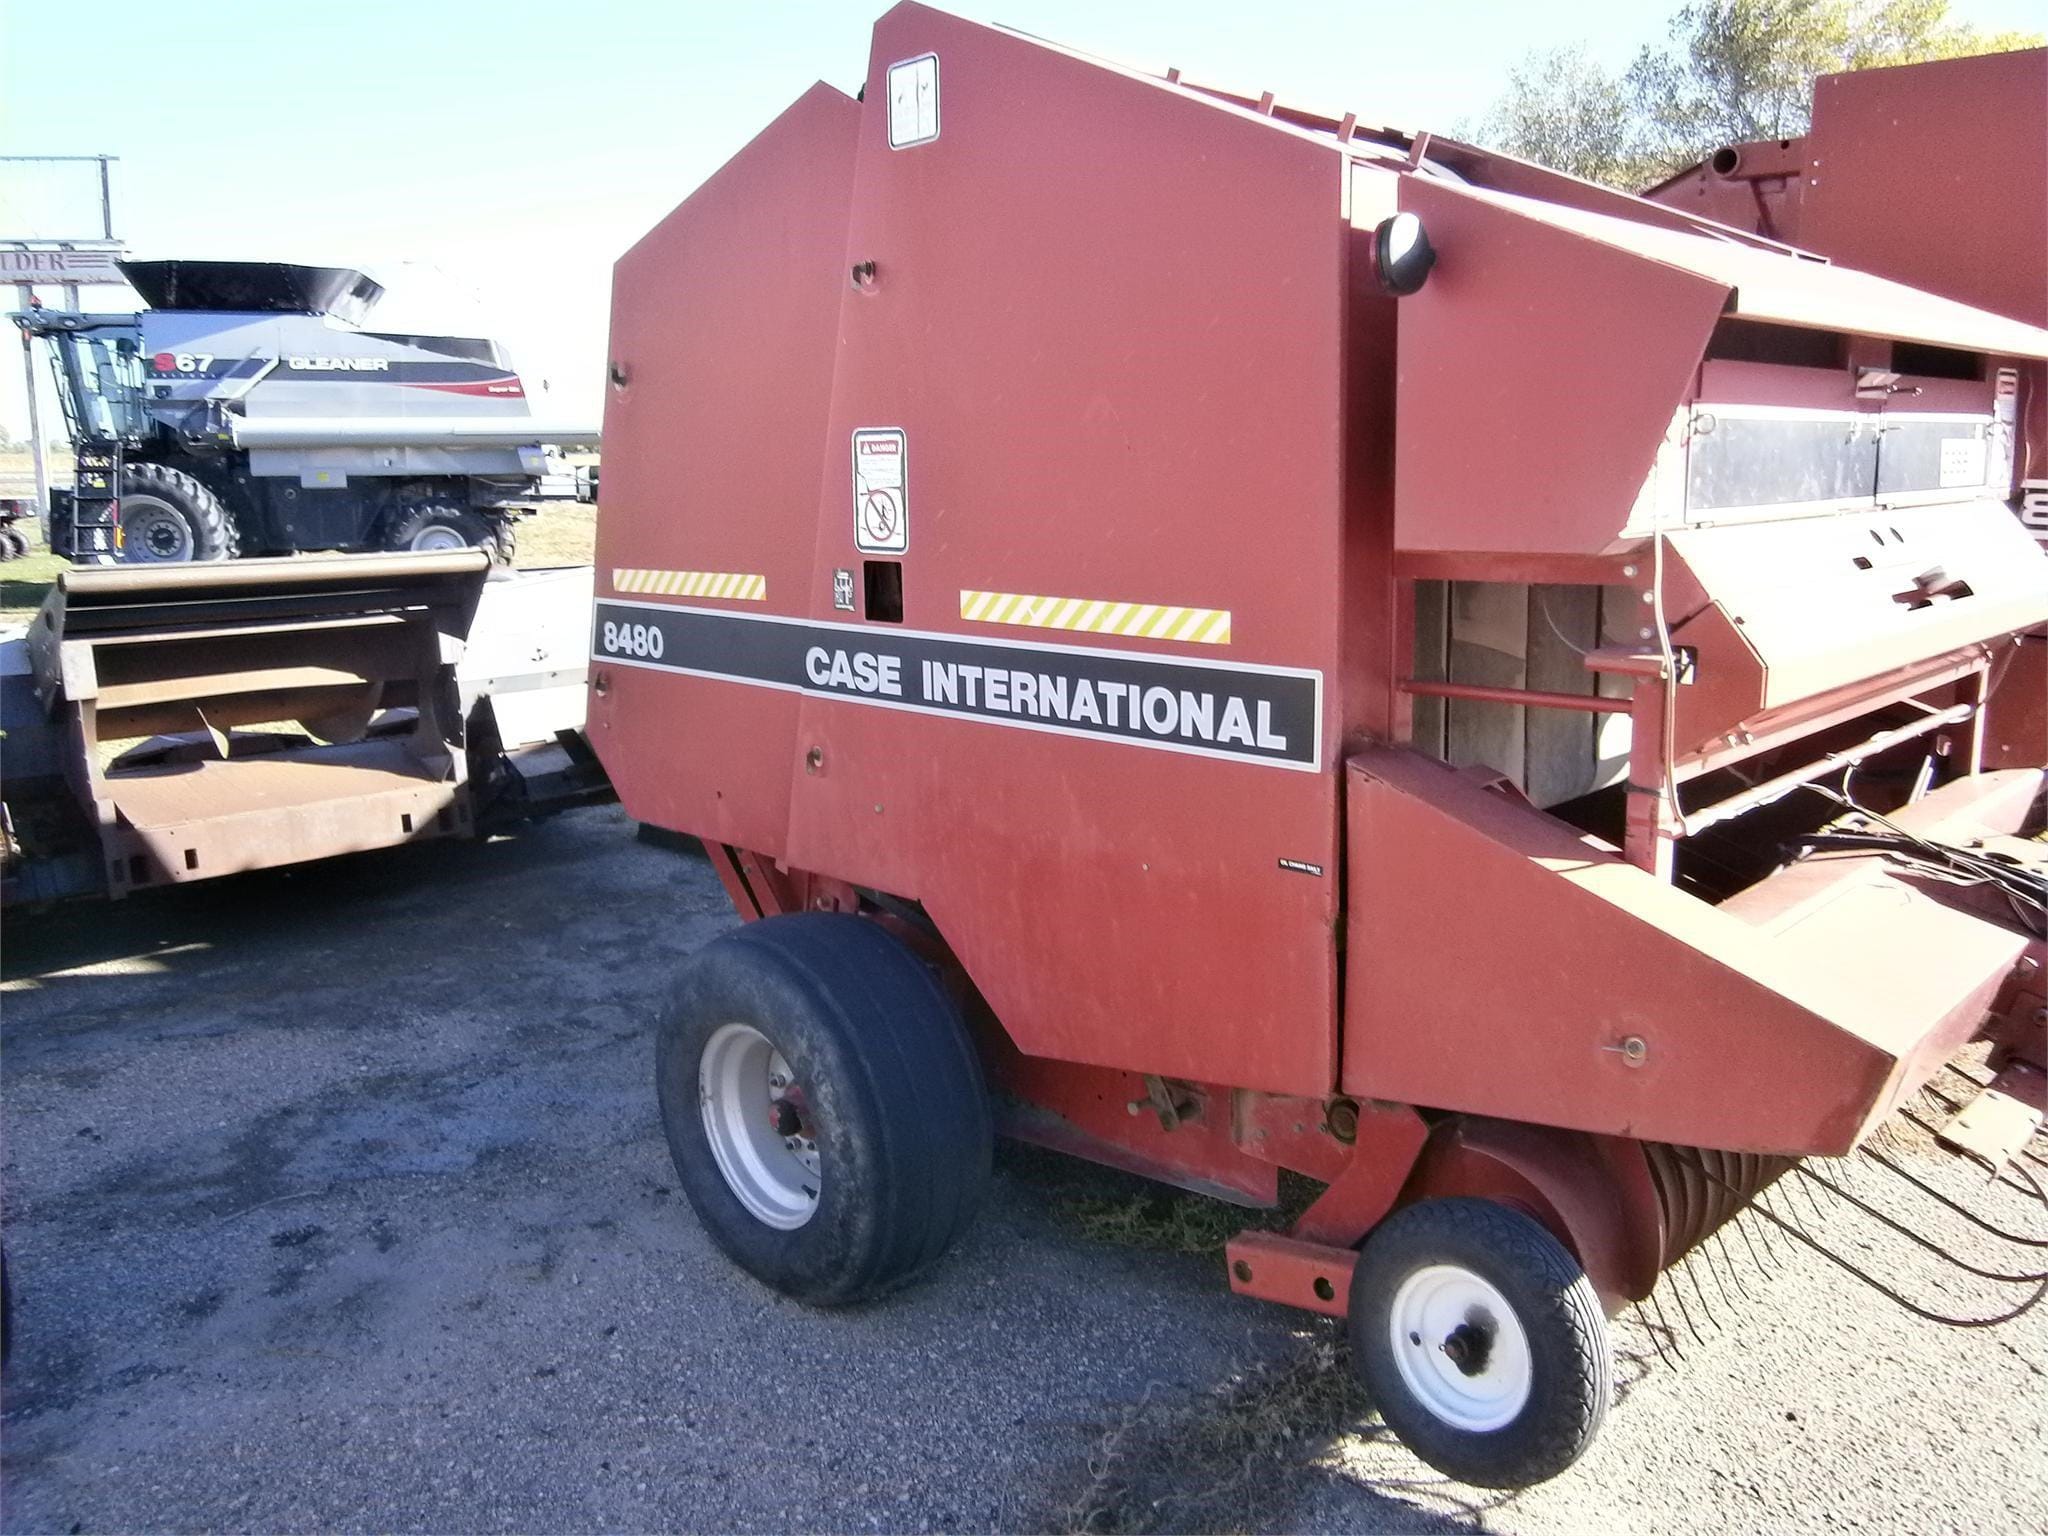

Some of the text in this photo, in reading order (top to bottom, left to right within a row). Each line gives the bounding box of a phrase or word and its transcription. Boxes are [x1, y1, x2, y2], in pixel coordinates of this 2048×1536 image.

[153, 352, 214, 373] S67
[289, 357, 389, 371] GLEANER
[603, 621, 664, 659] 8480
[805, 646, 1287, 752] CASE INTERNATIONAL
